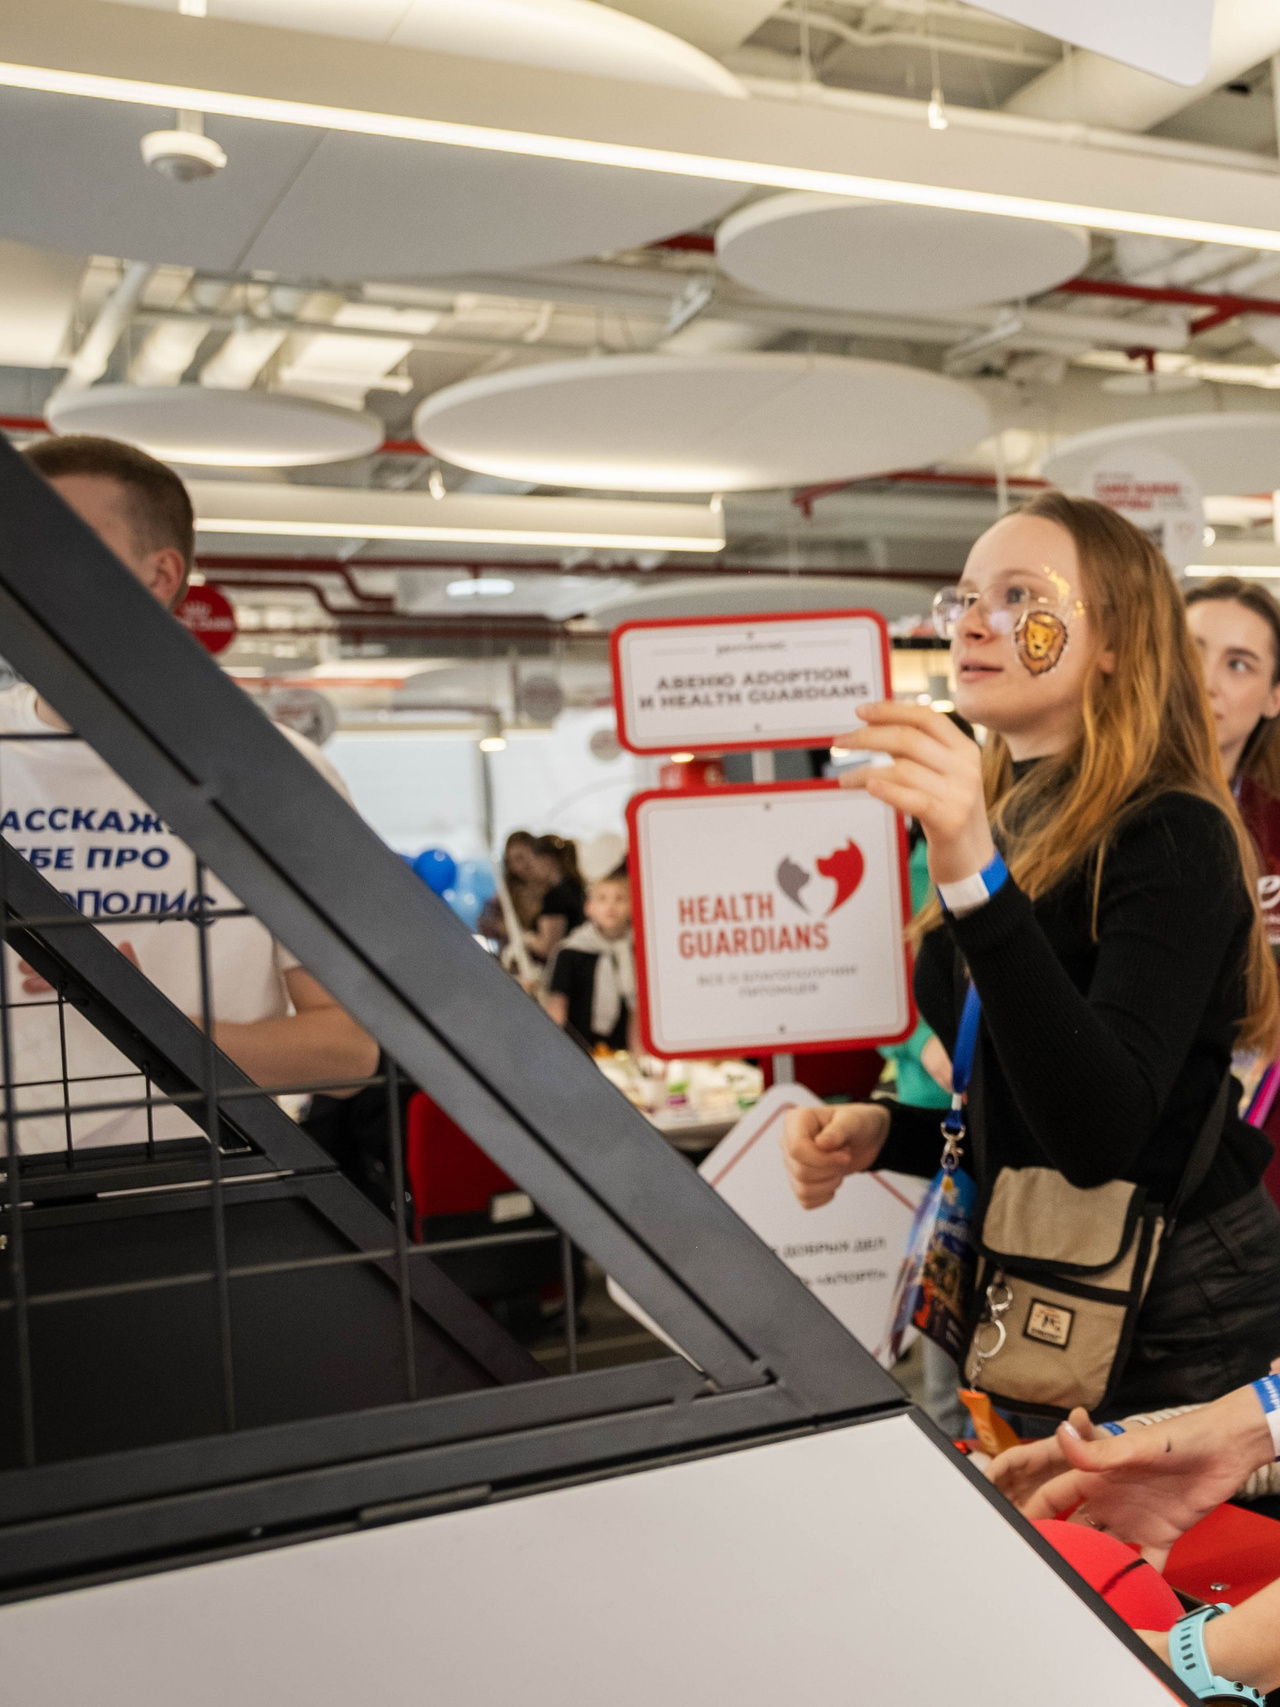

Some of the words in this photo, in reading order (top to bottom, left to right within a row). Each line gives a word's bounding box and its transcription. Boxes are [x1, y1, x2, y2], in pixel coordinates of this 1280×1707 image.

[743, 667, 850, 686] ADOPTION
[661, 691, 742, 709] HEALTH
[748, 684, 868, 703] GUARDIANS
[0, 808, 173, 834] АССКАЖ
[16, 847, 75, 870] БЕ
[86, 847, 170, 870] ПРО
[678, 892, 774, 925] HEALTH
[678, 921, 830, 960] GUARDIANS
